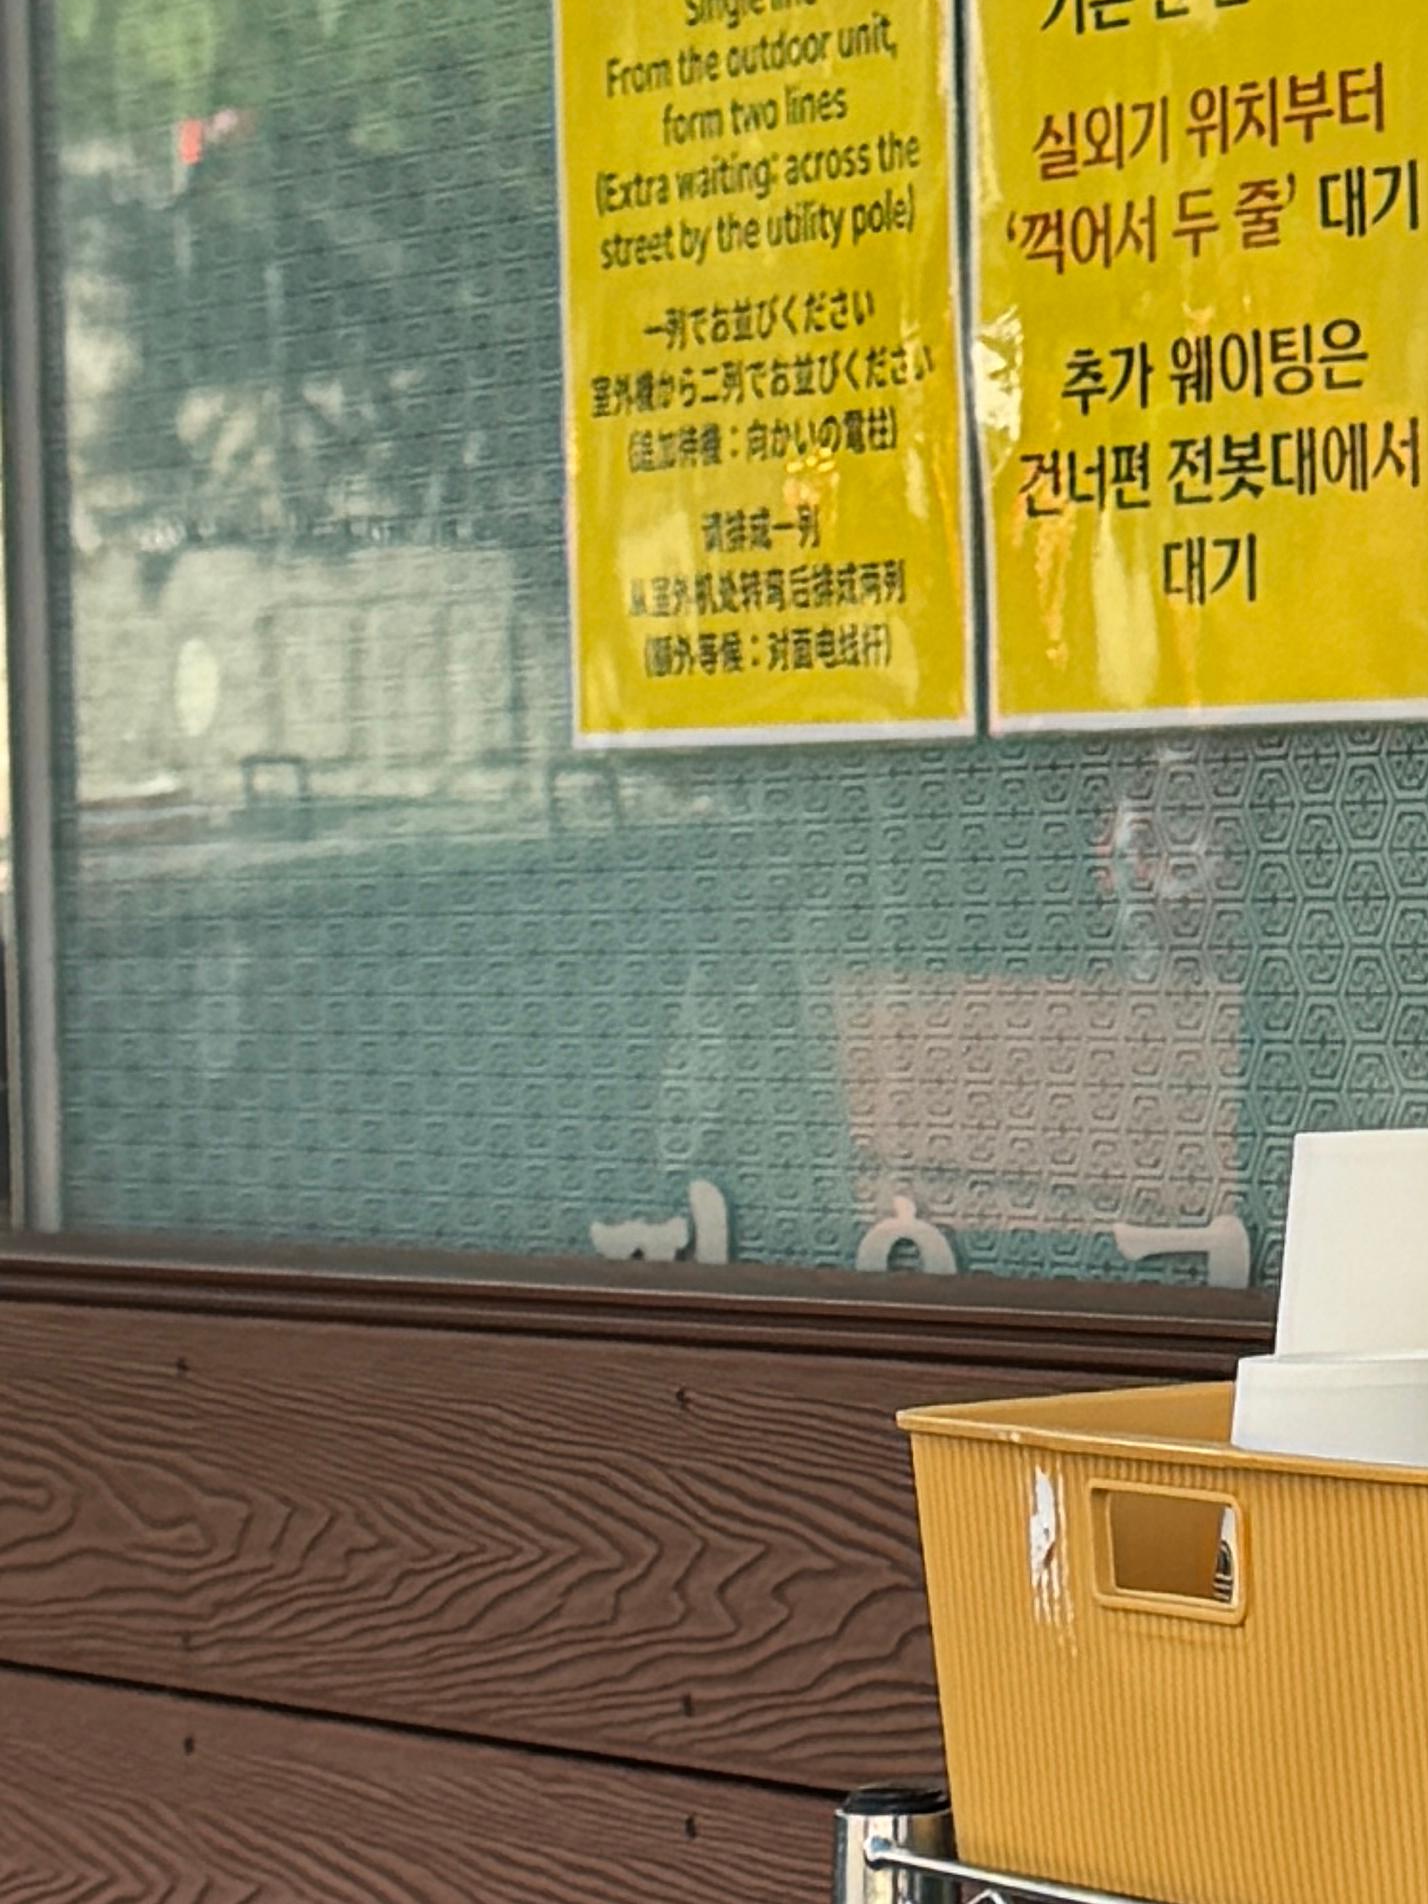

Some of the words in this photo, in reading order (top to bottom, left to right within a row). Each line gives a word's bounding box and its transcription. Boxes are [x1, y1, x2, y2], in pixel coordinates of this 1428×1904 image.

[606, 53, 672, 98] From
[677, 42, 720, 86] the
[725, 26, 830, 79] outdoor
[838, 11, 897, 63] unit,
[662, 100, 724, 146] form
[730, 96, 779, 133] two
[784, 83, 848, 123] lines
[1031, 94, 1169, 183] 실외기
[1185, 61, 1386, 159] 위치부터
[594, 169, 672, 218] (Extra
[675, 151, 780, 205] waiting:
[785, 142, 872, 188] across
[878, 130, 921, 173] the
[1172, 187, 1220, 258] 두
[1318, 160, 1421, 238] 대기
[600, 226, 673, 272] street
[678, 220, 711, 266] by
[717, 211, 761, 253] the
[765, 198, 844, 248] utility
[850, 187, 917, 241] pole)
[642, 287, 876, 351] 一列でお並びください
[1059, 342, 1155, 418] 추가
[1168, 316, 1370, 405] 웨이팅은
[1017, 435, 1151, 517] 건너편
[1165, 416, 1421, 509] 전봇대에서
[1161, 531, 1259, 607] 대기
